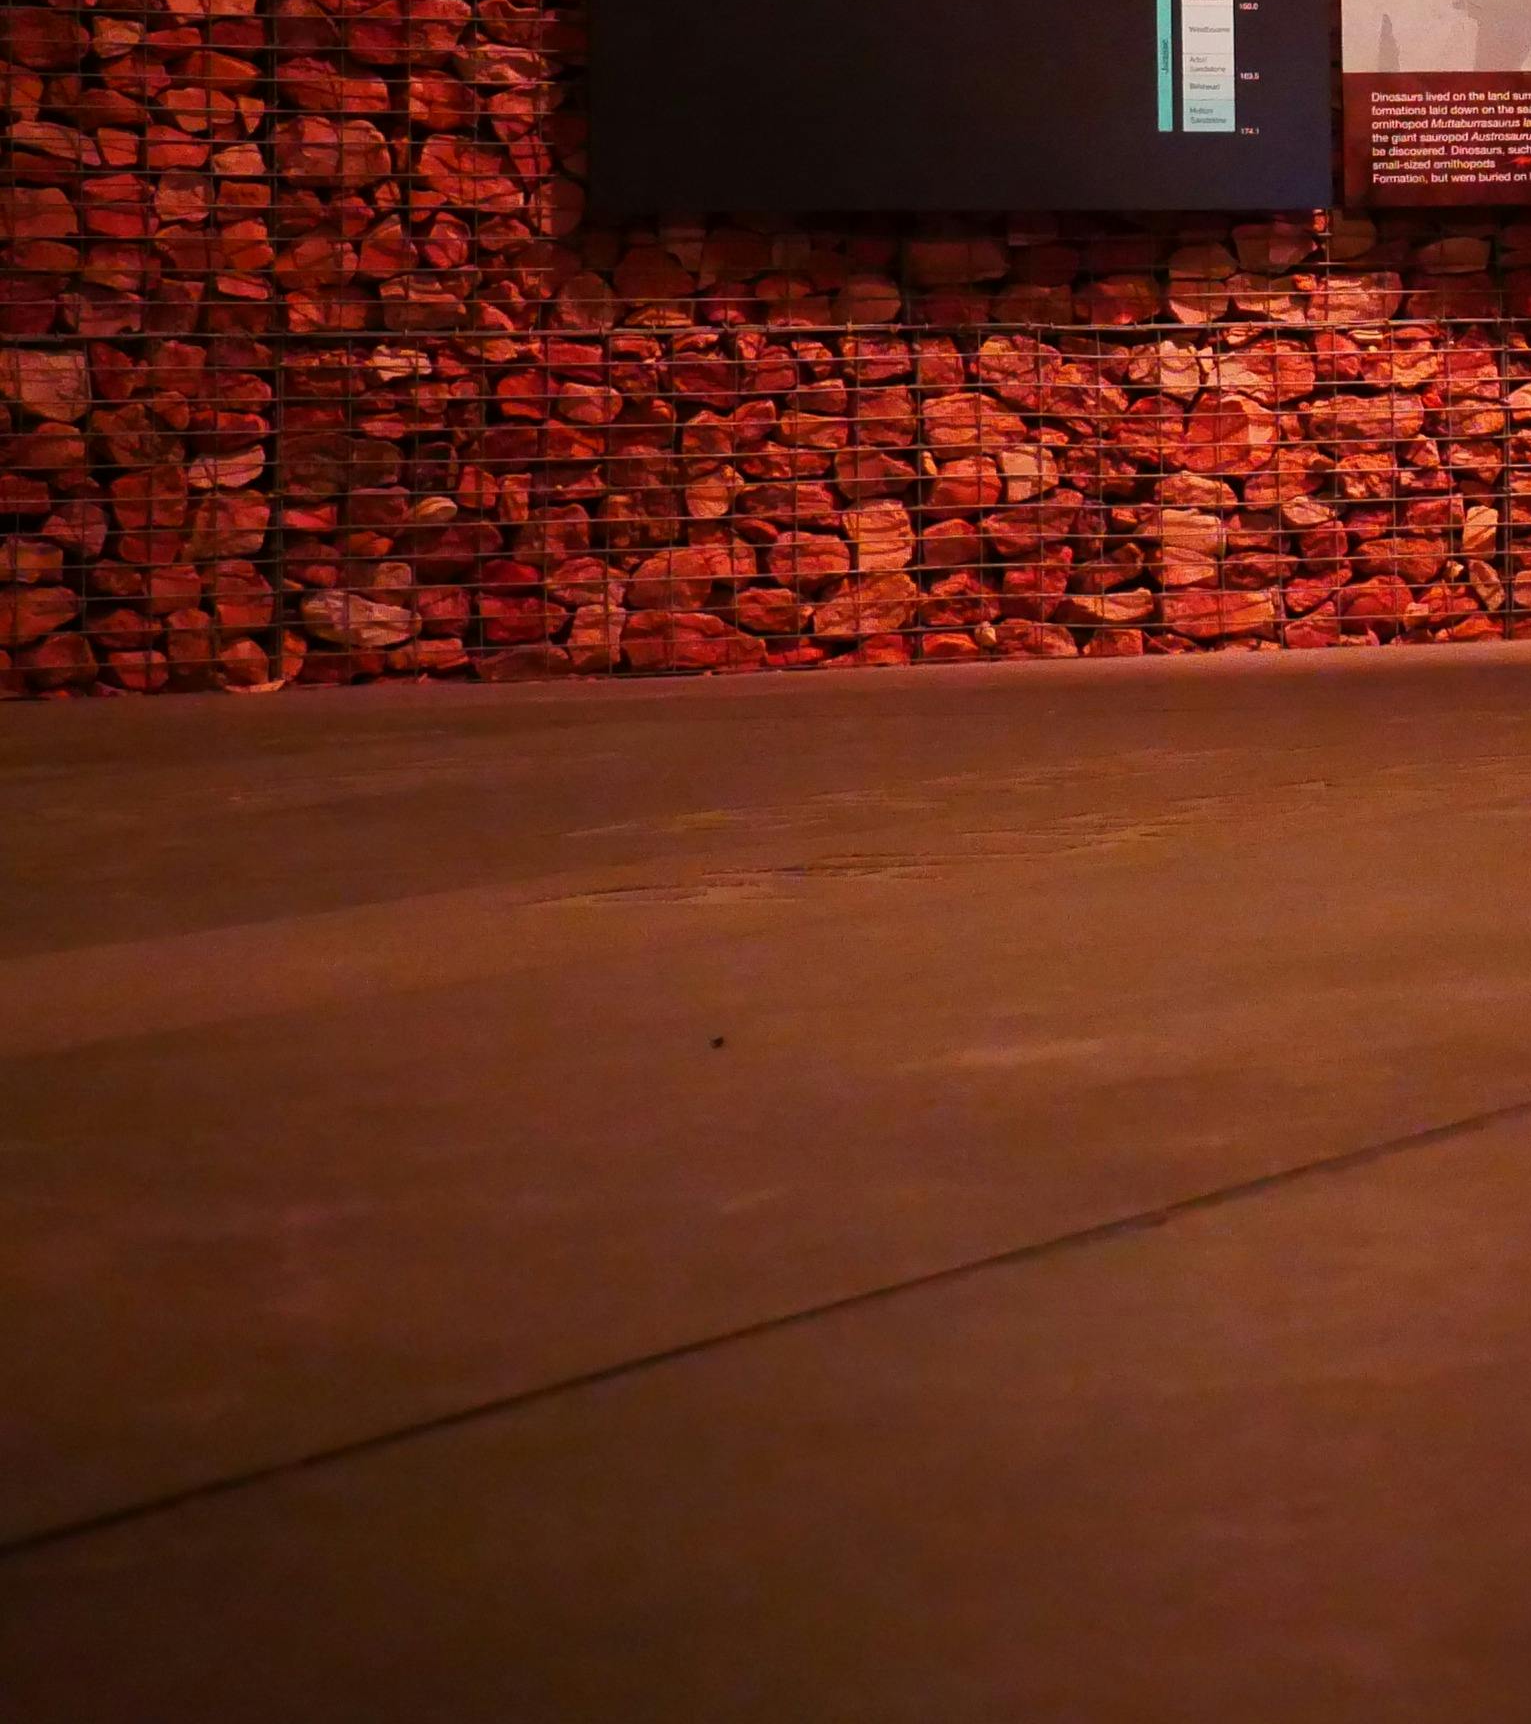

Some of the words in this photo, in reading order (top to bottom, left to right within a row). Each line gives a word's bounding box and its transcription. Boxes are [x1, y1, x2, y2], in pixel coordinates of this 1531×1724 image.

[1371, 91, 1424, 102] Dinosaurs
[1425, 91, 1450, 102] lived
[1452, 93, 1466, 102] on
[1468, 91, 1485, 101] the
[1488, 90, 1510, 101] land
